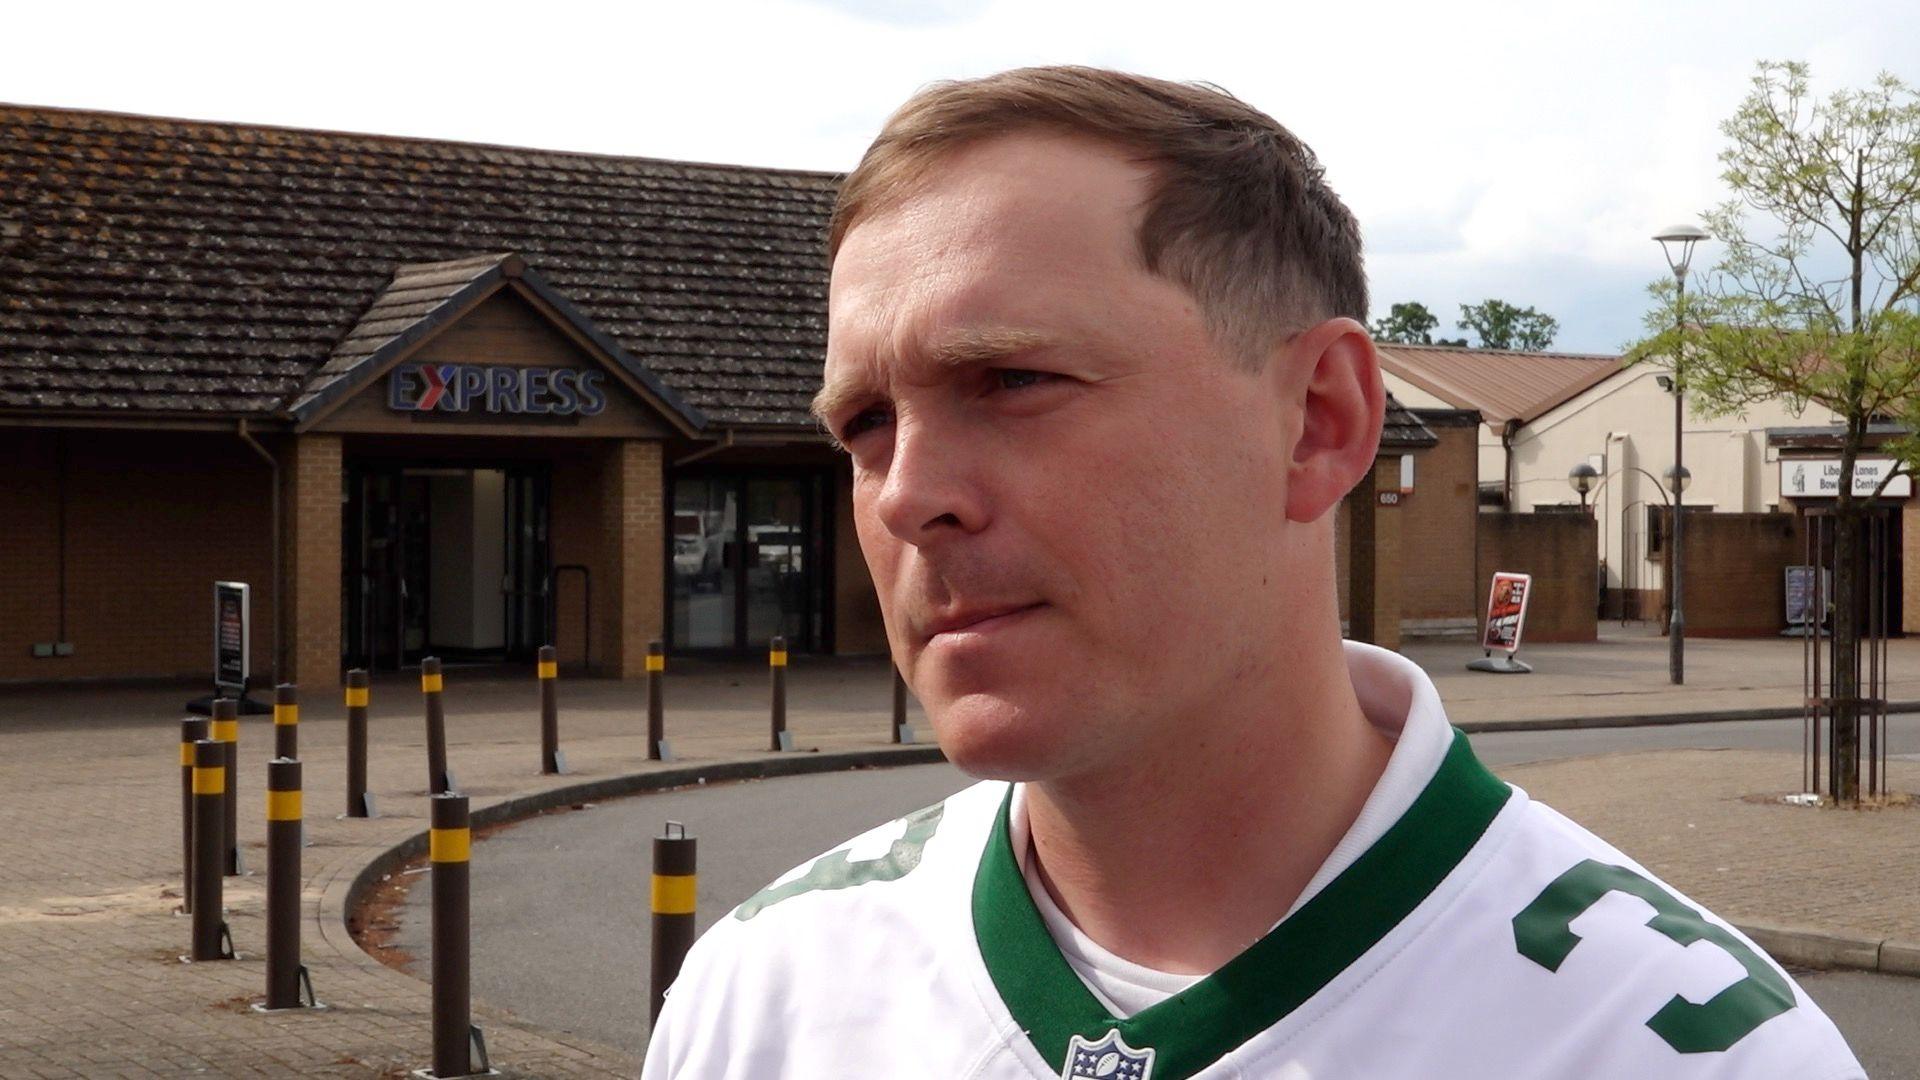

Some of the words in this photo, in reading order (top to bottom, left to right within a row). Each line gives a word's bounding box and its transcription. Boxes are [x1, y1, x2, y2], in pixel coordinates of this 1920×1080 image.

[389, 364, 606, 416] EXPRESS
[1854, 464, 1879, 476] Lanes
[1855, 478, 1880, 490] Cente
[1380, 493, 1398, 505] 650
[1511, 858, 1798, 1054] 3
